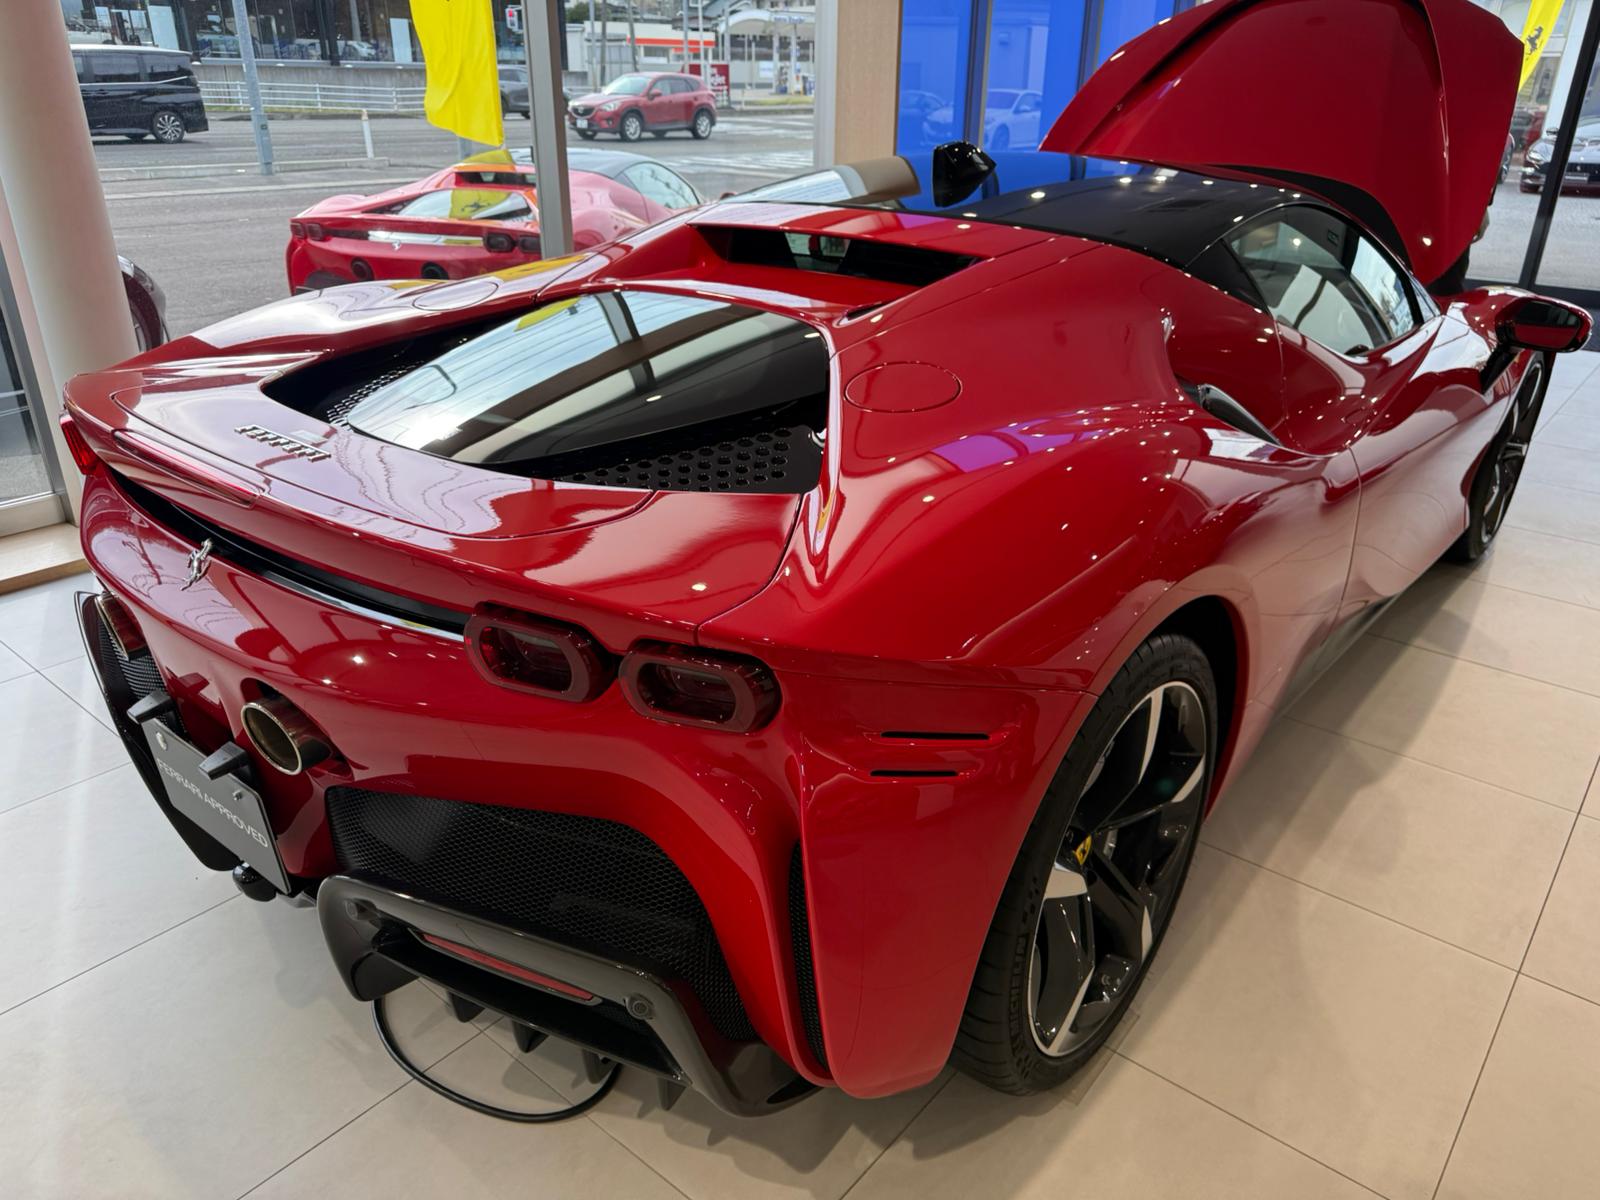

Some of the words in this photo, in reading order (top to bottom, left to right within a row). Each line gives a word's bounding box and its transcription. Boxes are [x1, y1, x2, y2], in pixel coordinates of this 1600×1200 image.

[234, 424, 331, 462] Ferrari
[156, 757, 203, 800] FERRARI
[203, 793, 268, 848] APPROVED
